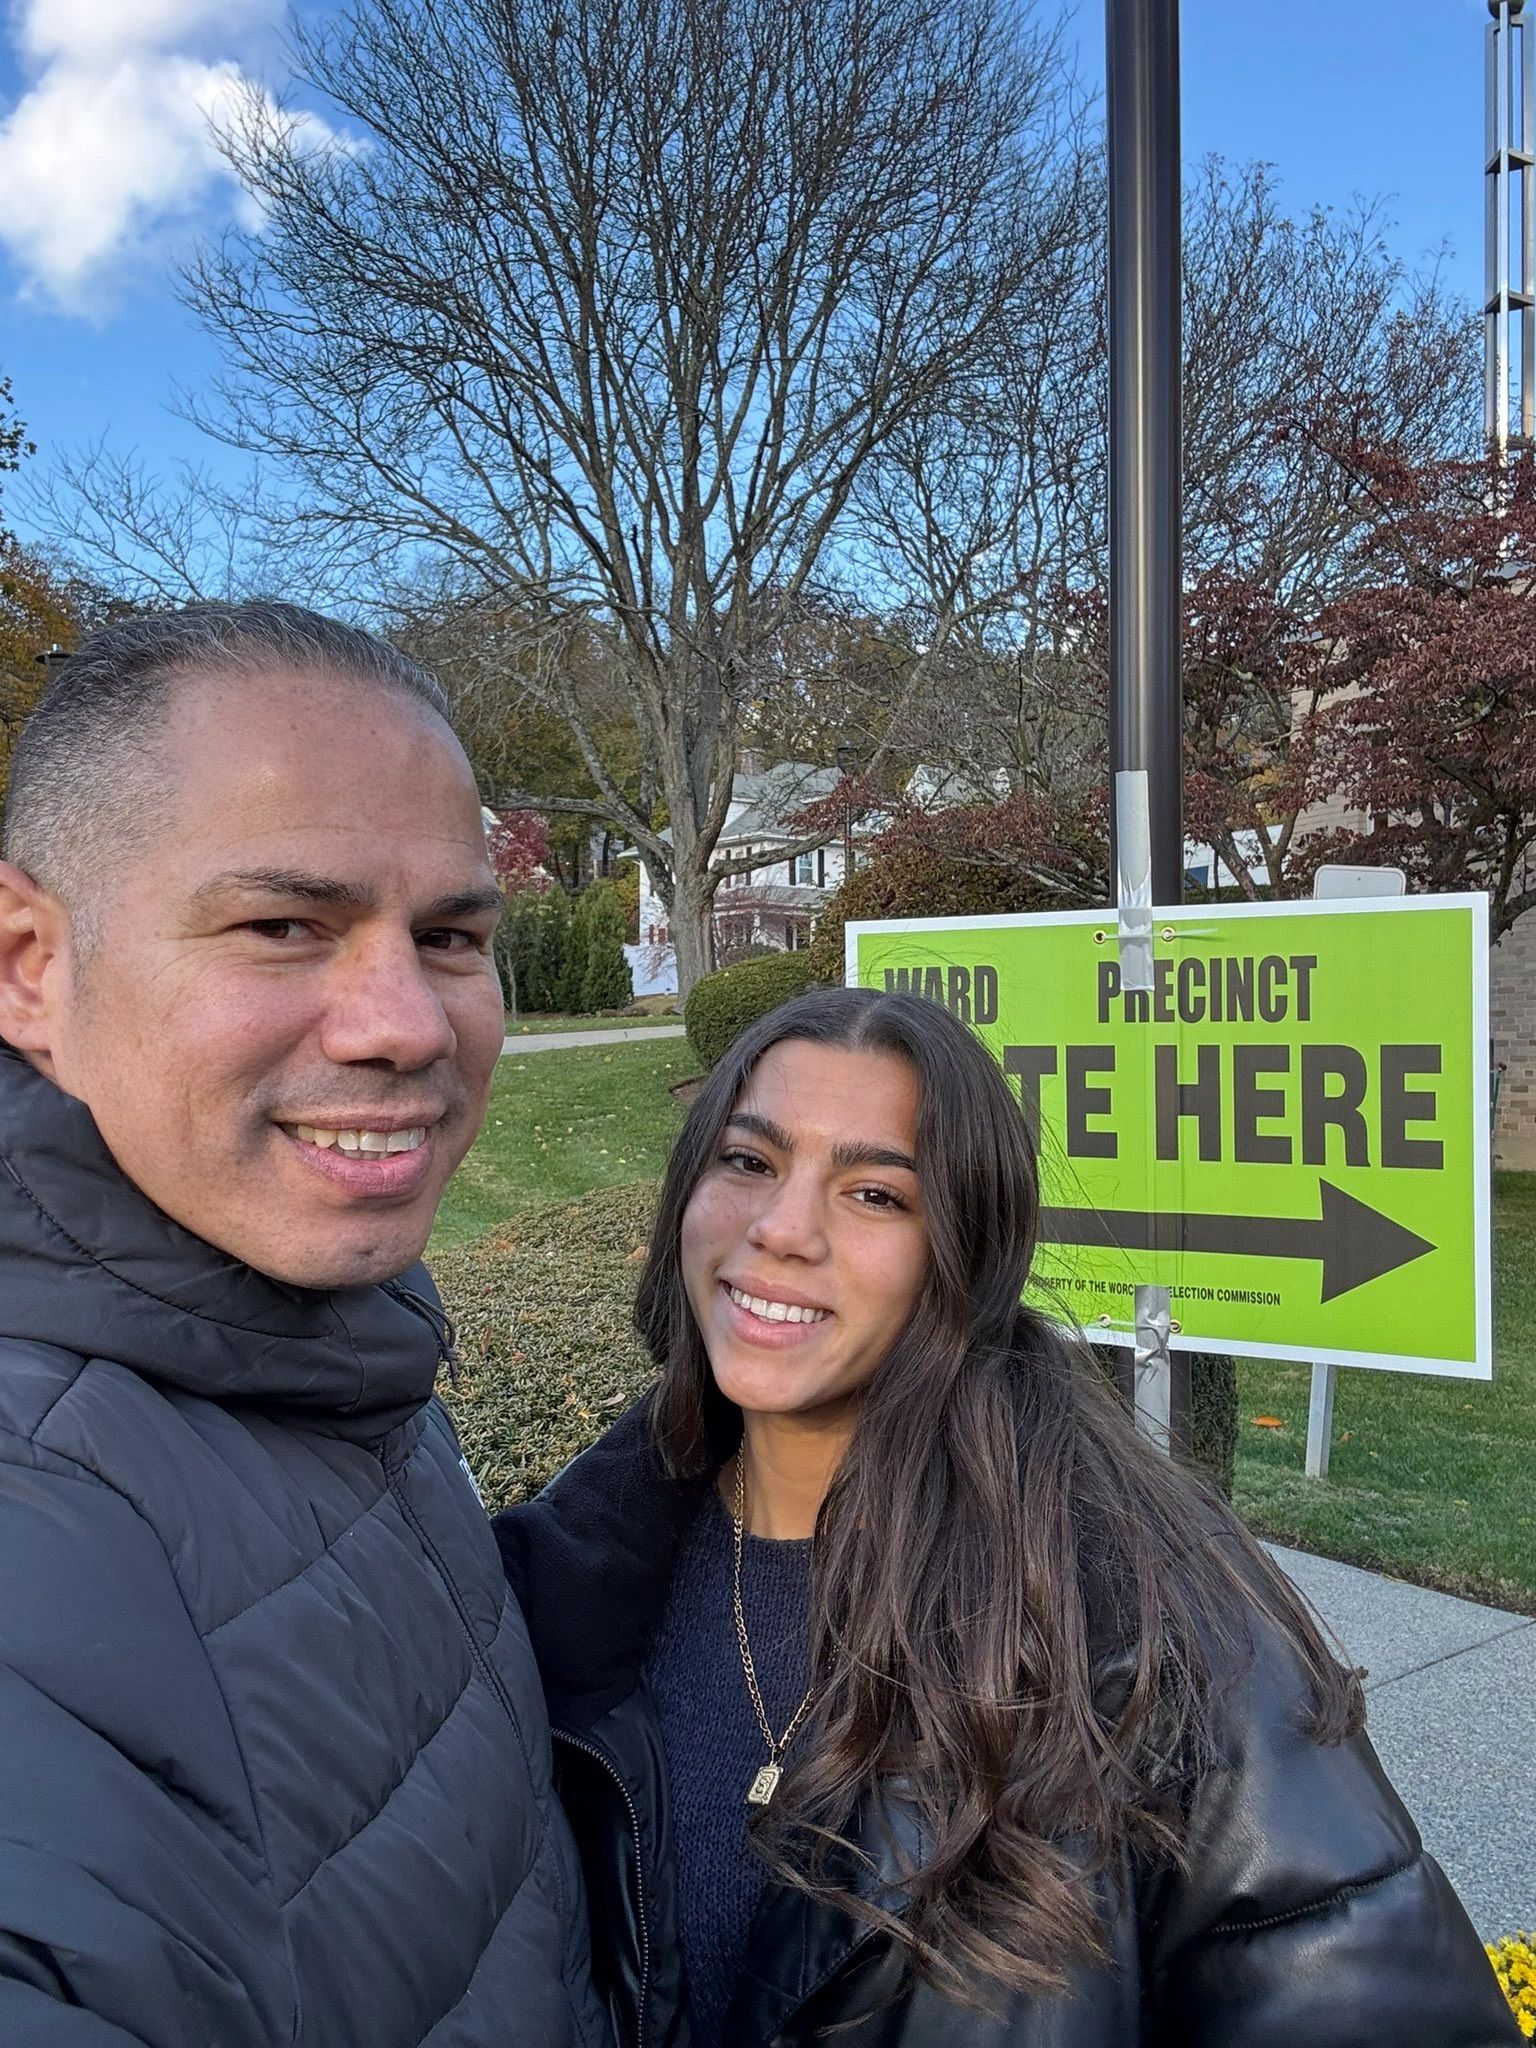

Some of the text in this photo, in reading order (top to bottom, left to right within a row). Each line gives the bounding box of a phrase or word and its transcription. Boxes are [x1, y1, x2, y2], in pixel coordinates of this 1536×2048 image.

[1098, 955, 1317, 1023] PRECINCT
[1003, 1044, 1444, 1170] TE HERE
[1031, 1276, 1073, 1291] OPERTY
[1075, 1279, 1087, 1291] OF
[1089, 1280, 1106, 1293] THE
[1217, 1289, 1281, 1306] COMMISSION
